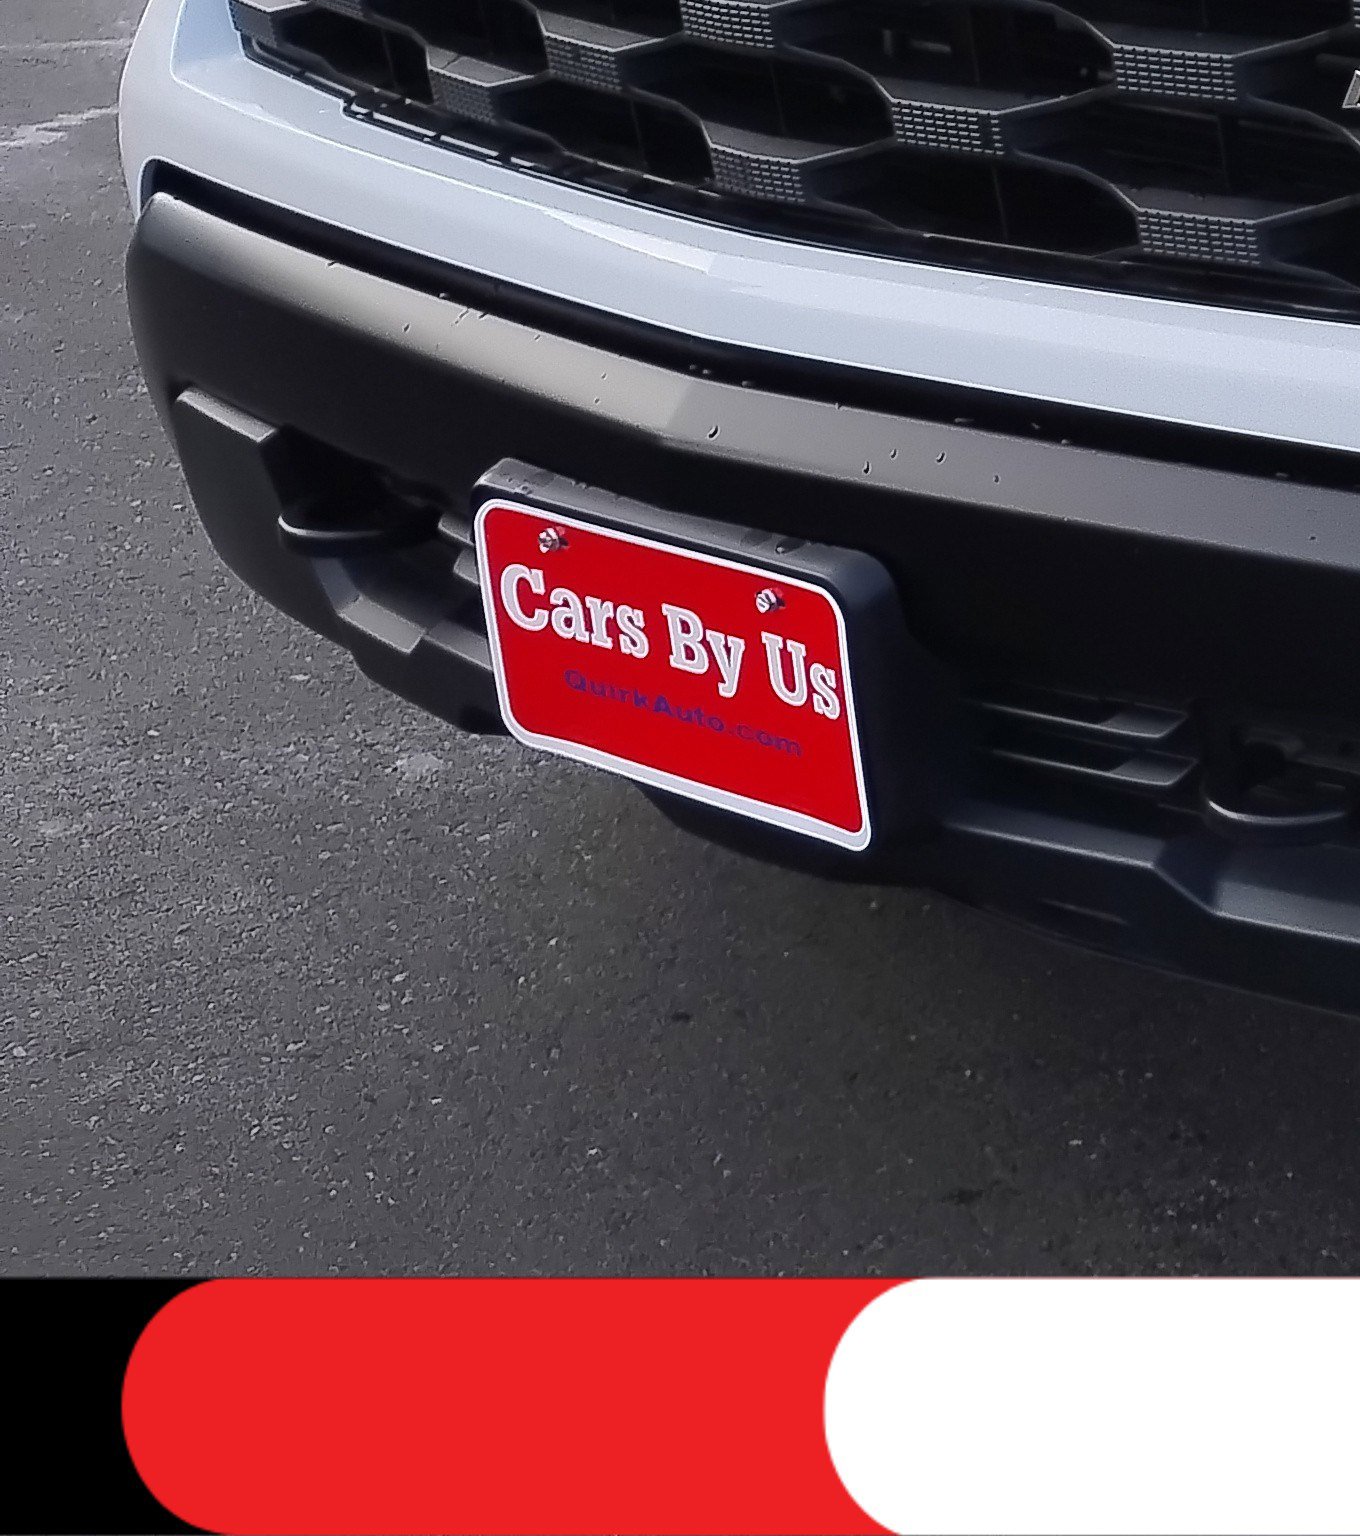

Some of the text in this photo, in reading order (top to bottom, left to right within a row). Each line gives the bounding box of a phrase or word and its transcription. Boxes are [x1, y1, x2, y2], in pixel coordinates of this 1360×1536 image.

[501, 563, 842, 722] Cars By Us
[564, 667, 802, 757] QuirkAuto.com
